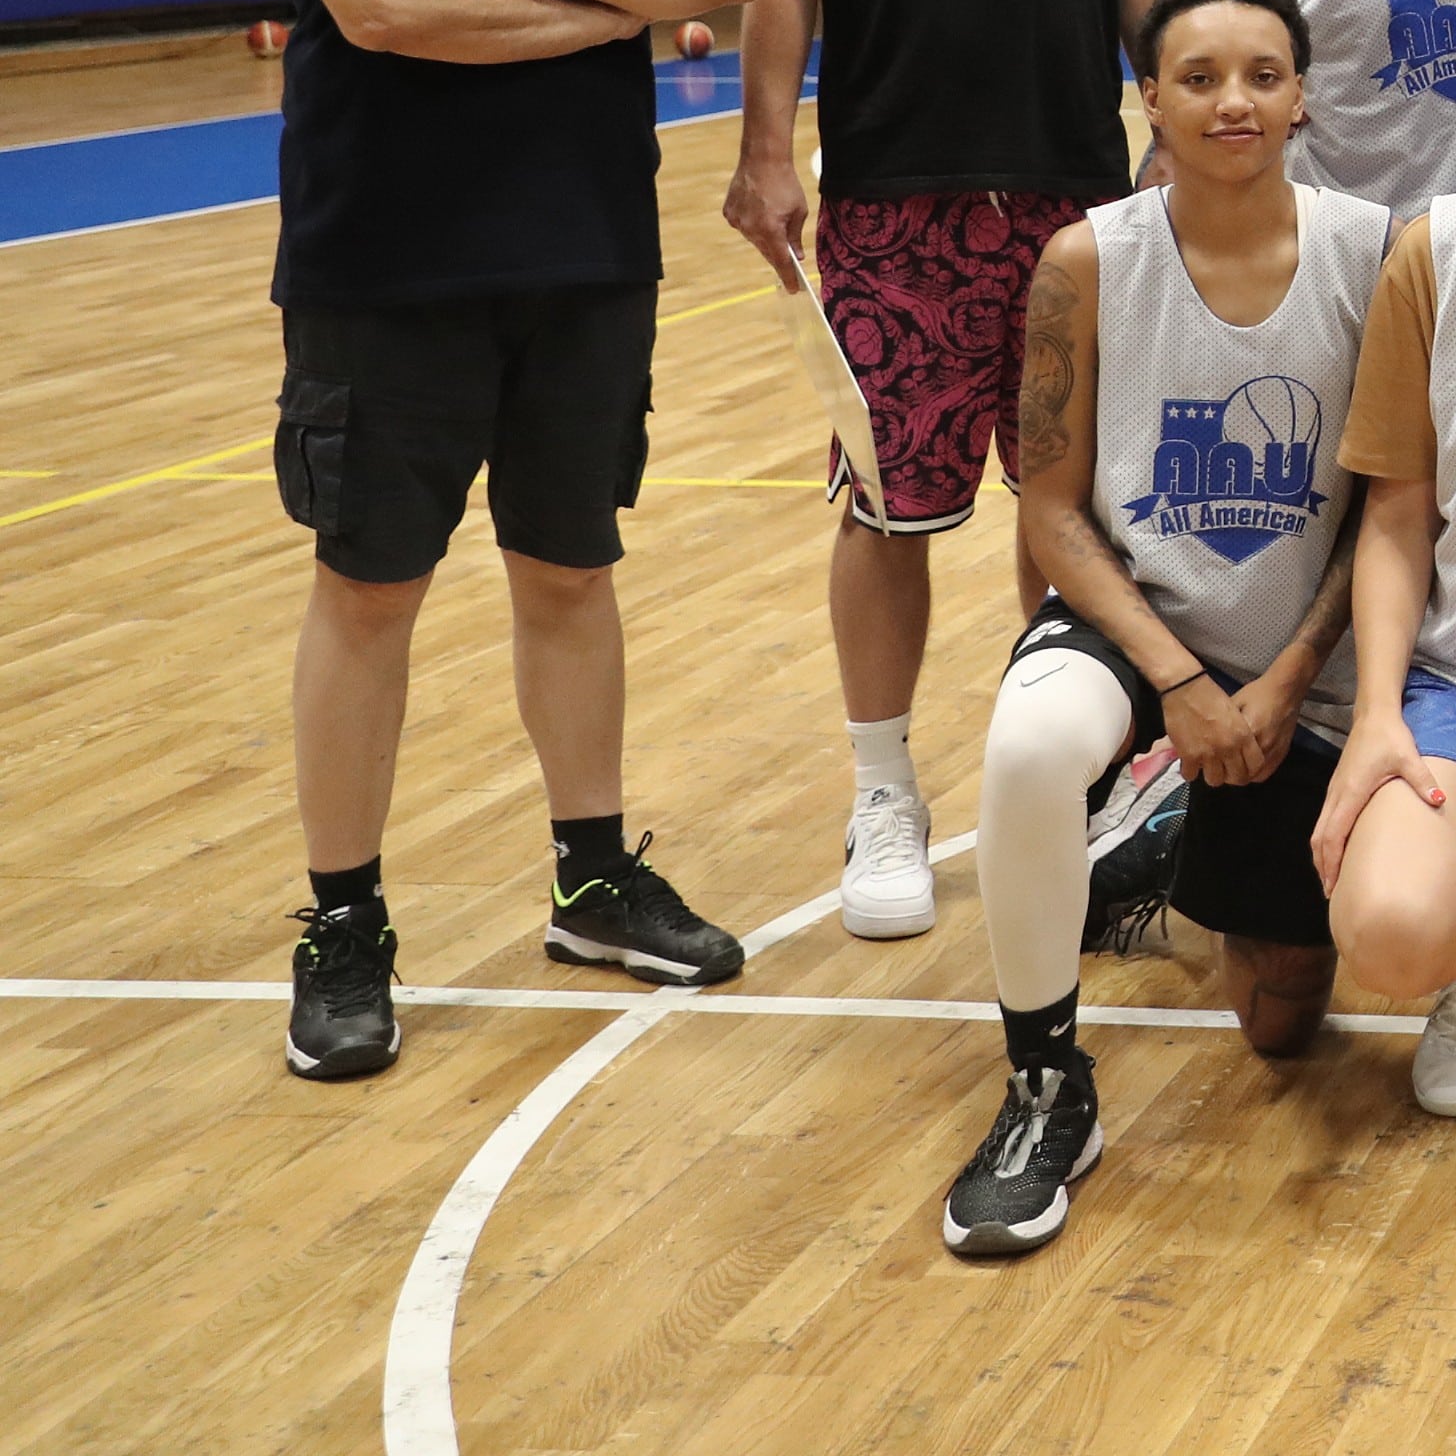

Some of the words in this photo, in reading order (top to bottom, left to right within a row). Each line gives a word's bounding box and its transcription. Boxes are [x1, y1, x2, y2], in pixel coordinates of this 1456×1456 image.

[1403, 69, 1431, 95] All
[1160, 505, 1192, 537] All
[1199, 500, 1307, 534] American
